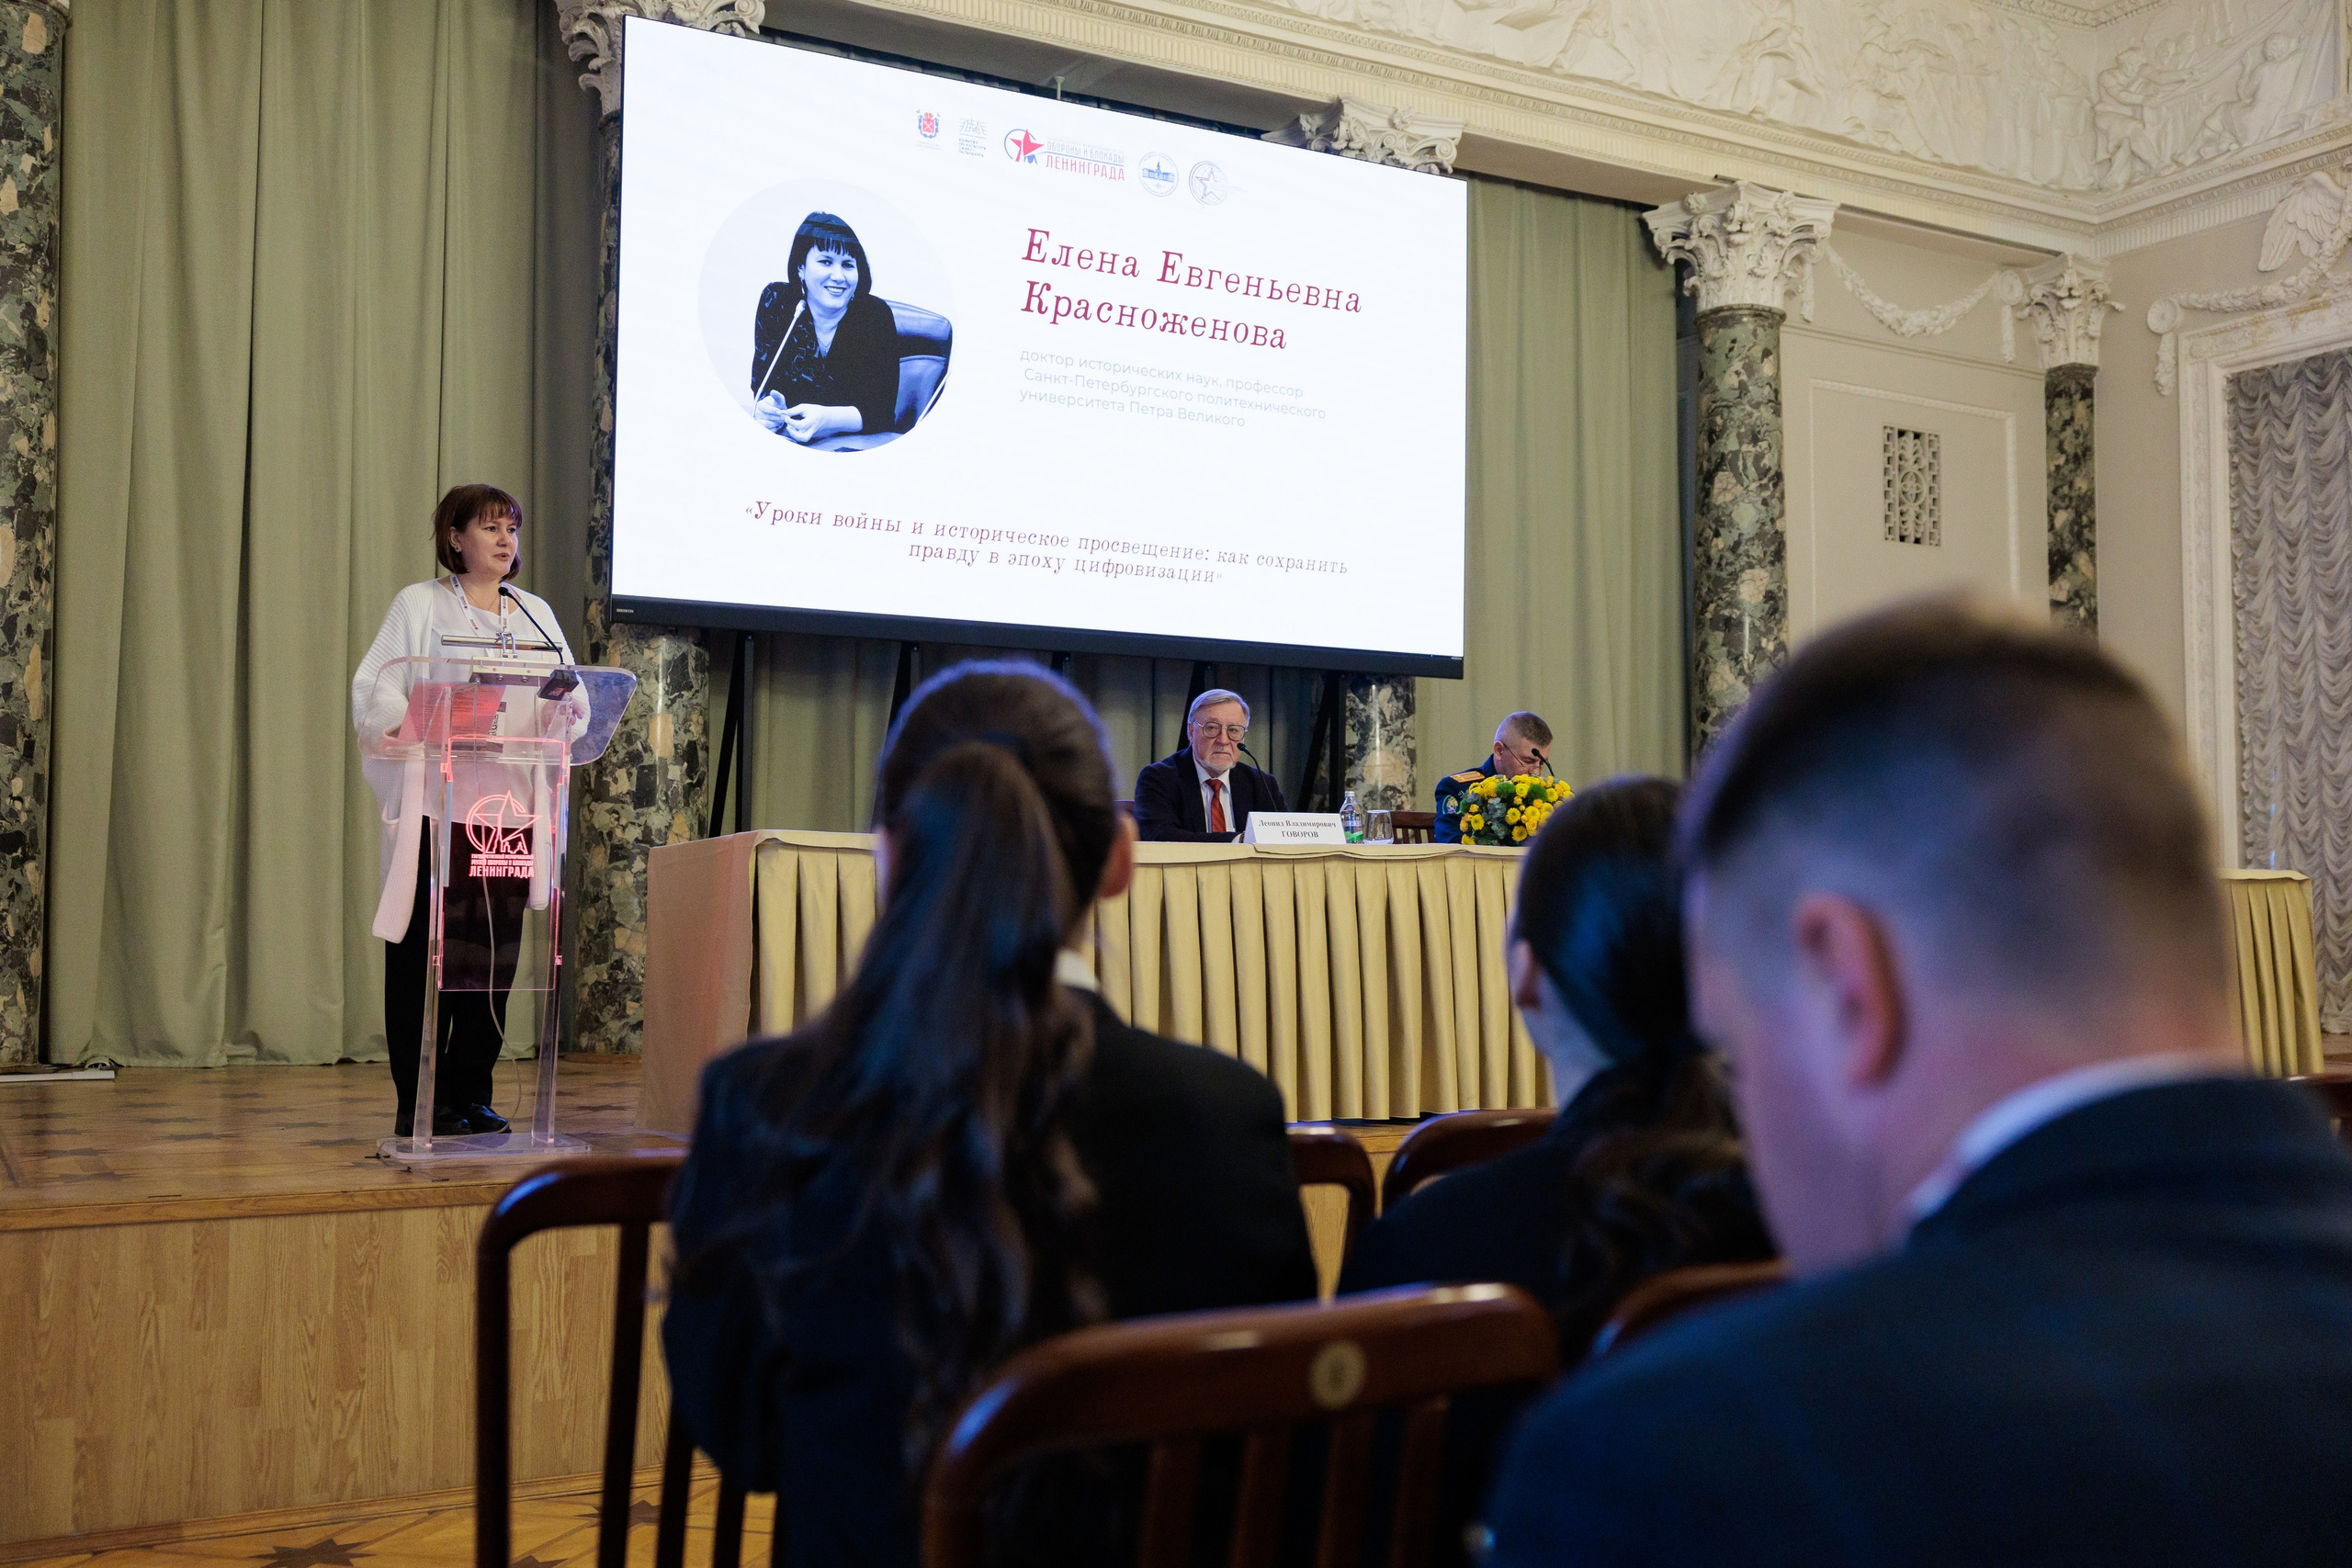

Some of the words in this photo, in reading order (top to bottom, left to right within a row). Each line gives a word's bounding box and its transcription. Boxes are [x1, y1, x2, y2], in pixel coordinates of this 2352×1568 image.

[1046, 141, 1081, 156] ОБОРОНЫ
[1083, 147, 1088, 157] И
[1090, 149, 1125, 164] БЛОКАДЫ
[1046, 154, 1125, 182] ЛЕНИНГРАДА
[1022, 228, 1140, 277] Елена
[1157, 250, 1363, 312] Евгеньевна
[1021, 279, 1287, 349] Красноженова
[1020, 349, 1075, 368] доктор
[1079, 357, 1182, 382] исторических
[1186, 371, 1223, 389] наук,
[1226, 377, 1304, 400] профессор
[1023, 367, 1193, 402] Санкт-Петербургского
[1196, 389, 1327, 420] политехнического
[1019, 389, 1125, 412] университета
[1129, 401, 1173, 420] Петра
[1177, 407, 1246, 427] Великого
[745, 501, 823, 526] «Уроки
[831, 512, 902, 533] войны
[910, 520, 924, 535] и
[933, 521, 1069, 550] историческое
[1077, 534, 1210, 561] просвещение:
[1216, 548, 1250, 565] как
[1256, 553, 1349, 575] сохранить
[908, 541, 980, 568] правду
[988, 551, 1000, 564] в
[1007, 553, 1066, 575] эпоху
[1073, 555, 1223, 584] цифровизации»
[1258, 819, 1284, 828] Леонид
[1285, 820, 1337, 829] Владимирович
[469, 865, 535, 878] ЛЕНИНГРАДА
